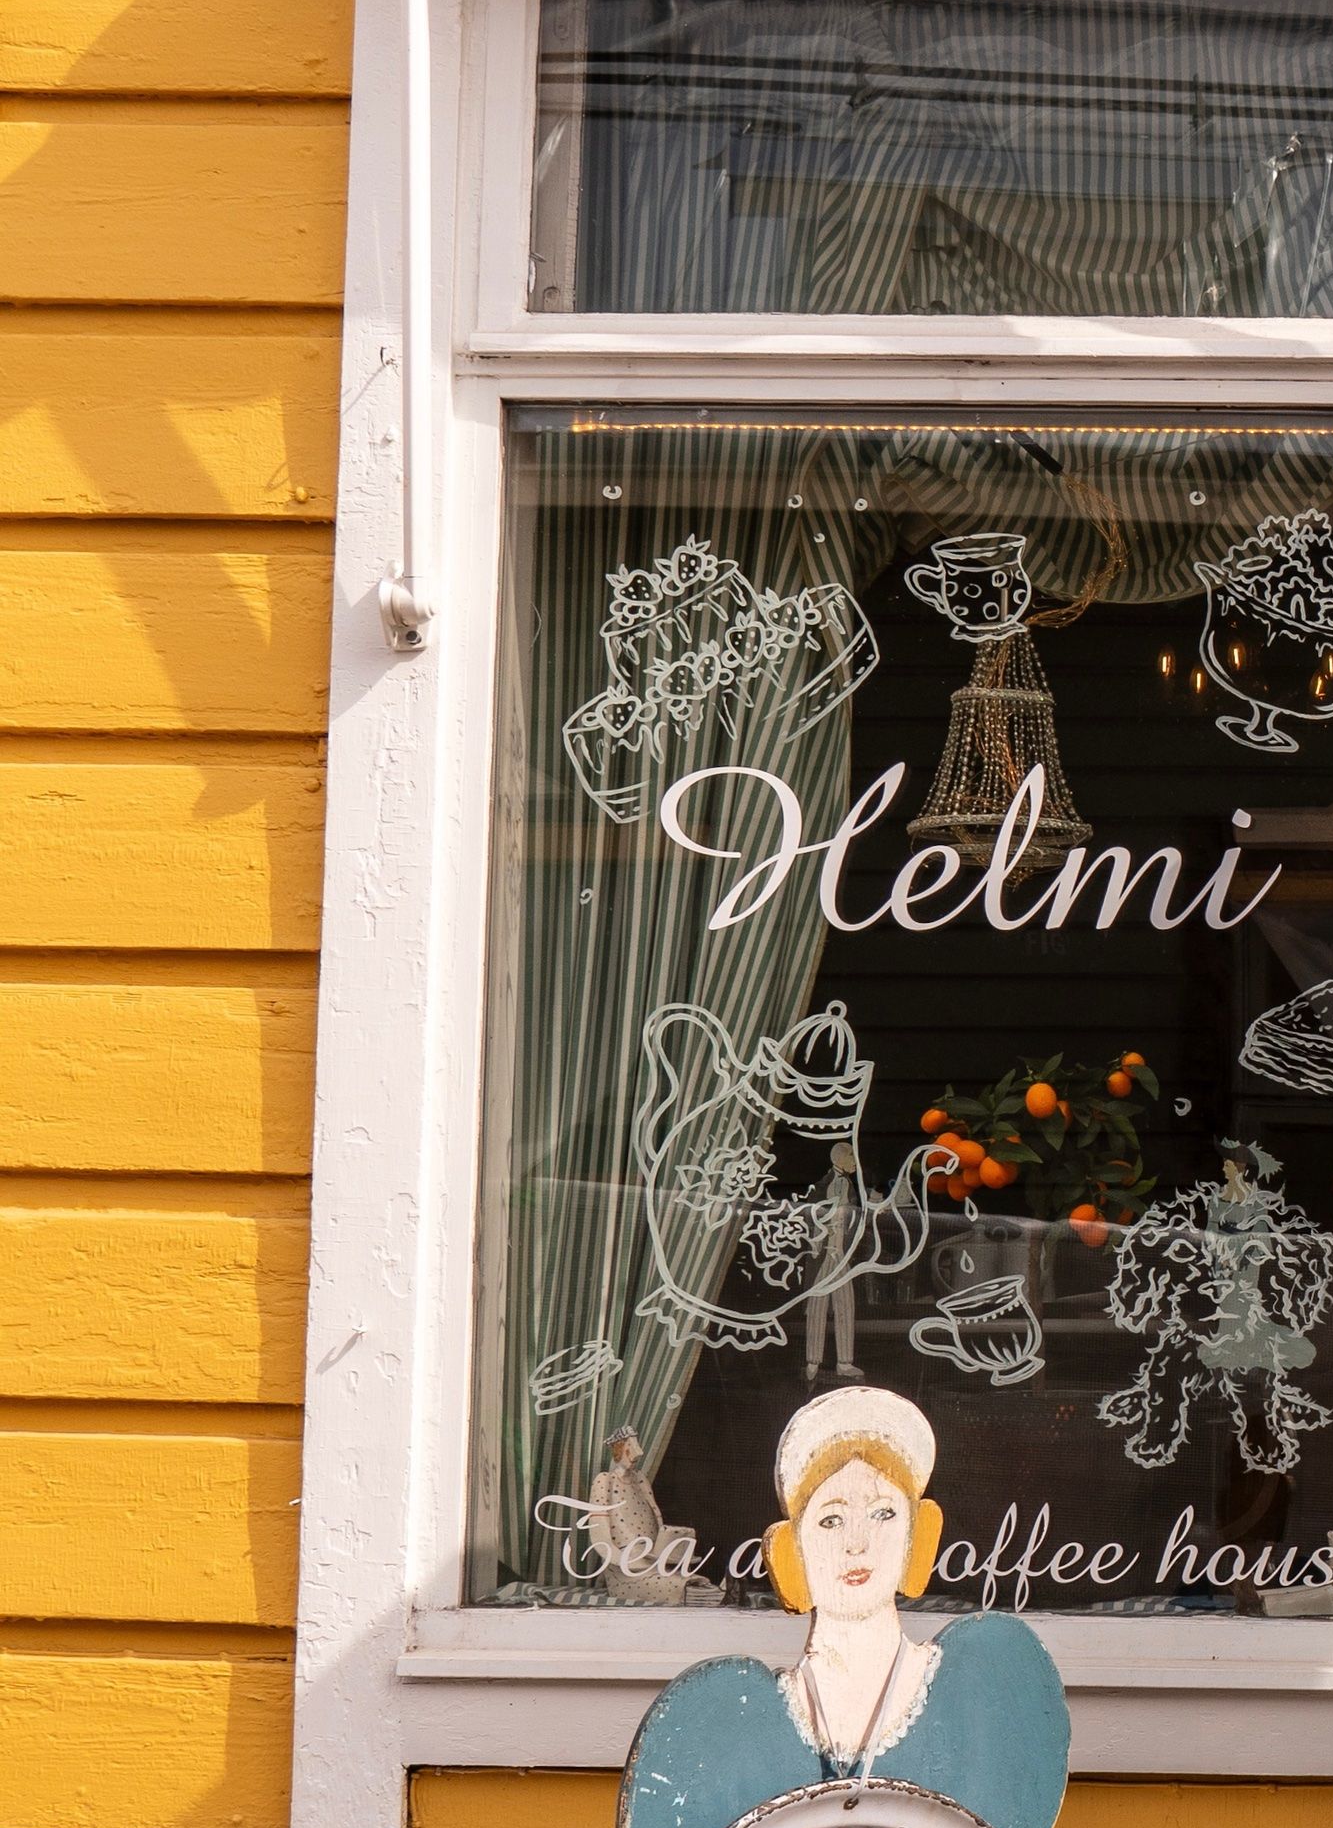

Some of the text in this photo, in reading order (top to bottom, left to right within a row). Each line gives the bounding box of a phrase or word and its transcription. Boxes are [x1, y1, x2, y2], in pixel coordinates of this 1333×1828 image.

[661, 762, 1281, 931] Helmi
[534, 1494, 716, 1579] Tea
[934, 1502, 1140, 1612] offee
